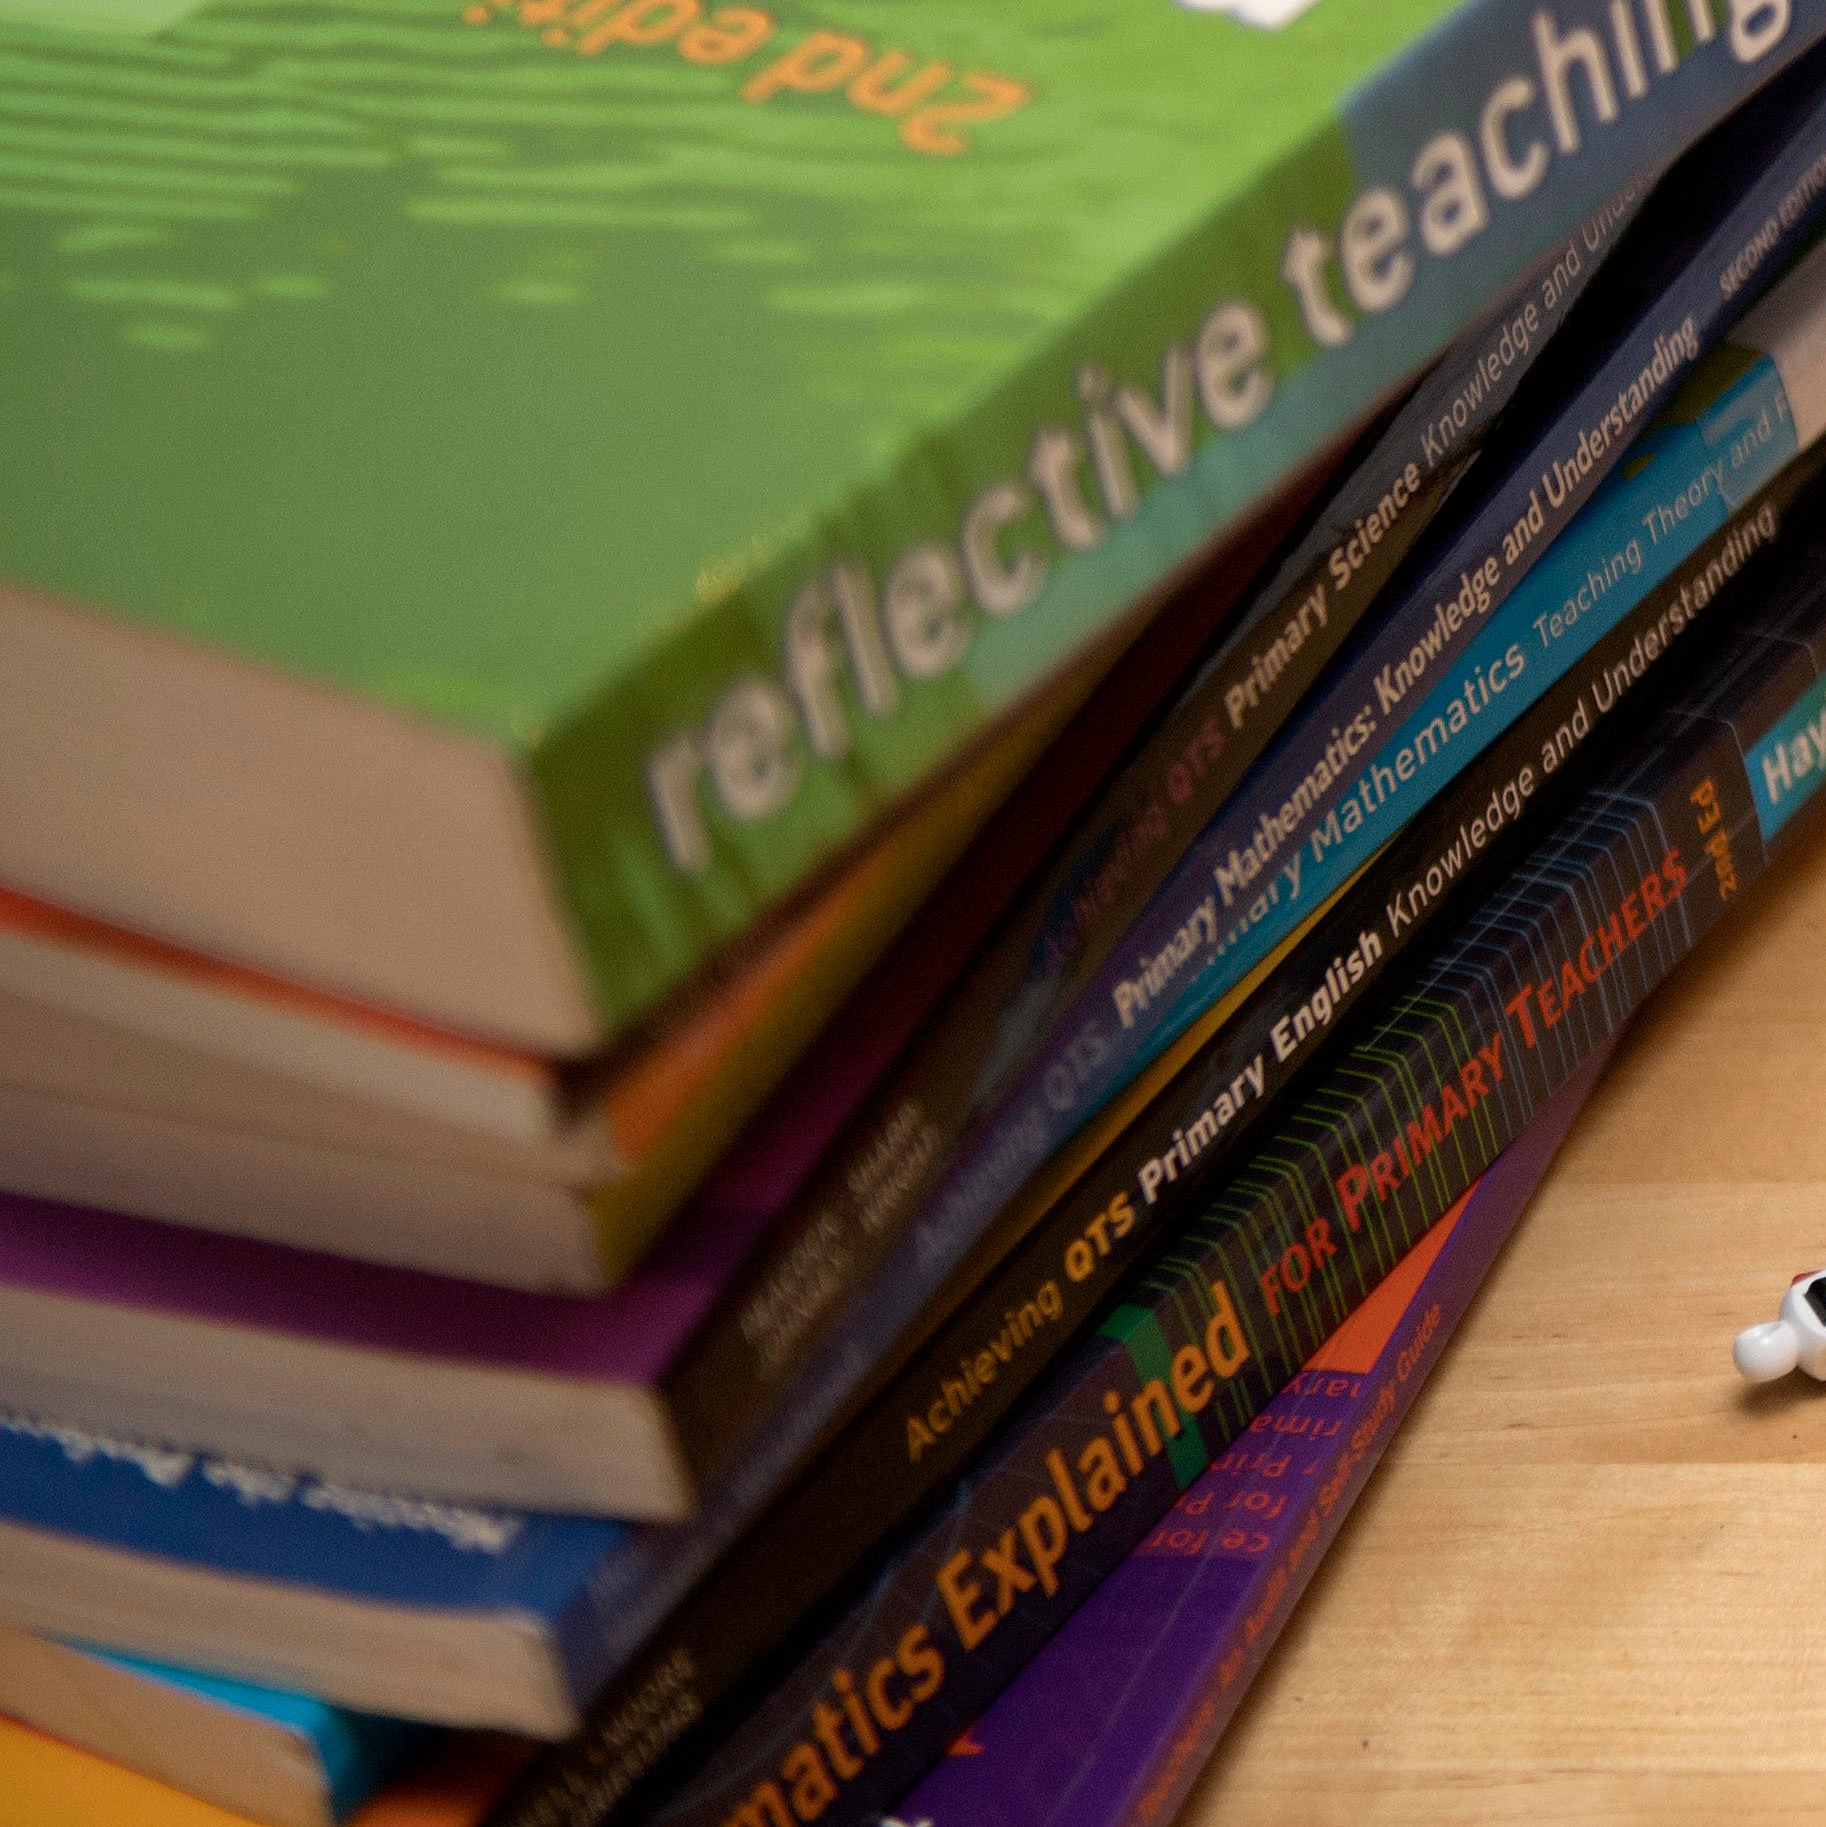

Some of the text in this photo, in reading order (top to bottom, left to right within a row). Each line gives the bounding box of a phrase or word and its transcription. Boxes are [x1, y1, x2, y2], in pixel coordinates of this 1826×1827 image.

[742, 20, 1032, 154] 2nd
[643, 296, 1274, 878] reflective
[1224, 578, 1332, 731] Primary
[1327, 451, 1426, 592] Science
[1418, 314, 1543, 469] Knowledge
[1540, 250, 1585, 310] and
[1109, 894, 1222, 1031] Primary
[1213, 701, 1382, 912] Mathematics:
[1371, 564, 1504, 706] Knowledge
[1500, 497, 1547, 569] and
[1541, 314, 1702, 513] Understanding
[1309, 644, 1530, 865] Mathematics
[1531, 543, 1645, 649] Teaching
[1640, 451, 1728, 549] Theory
[1728, 416, 1775, 472] and
[1688, 778, 1725, 835] Ed
[1702, 830, 1740, 903] 2nd
[900, 500, 1780, 1463] Achieving QTS Primary English Knowledge and Understanding
[1504, 848, 1689, 1053] TEACHERS
[1336, 1034, 1502, 1234] PRIMARY
[1258, 1220, 1342, 1322] FOR
[933, 1279, 1253, 1654] Explained
[1223, 1491, 1289, 1521] for
